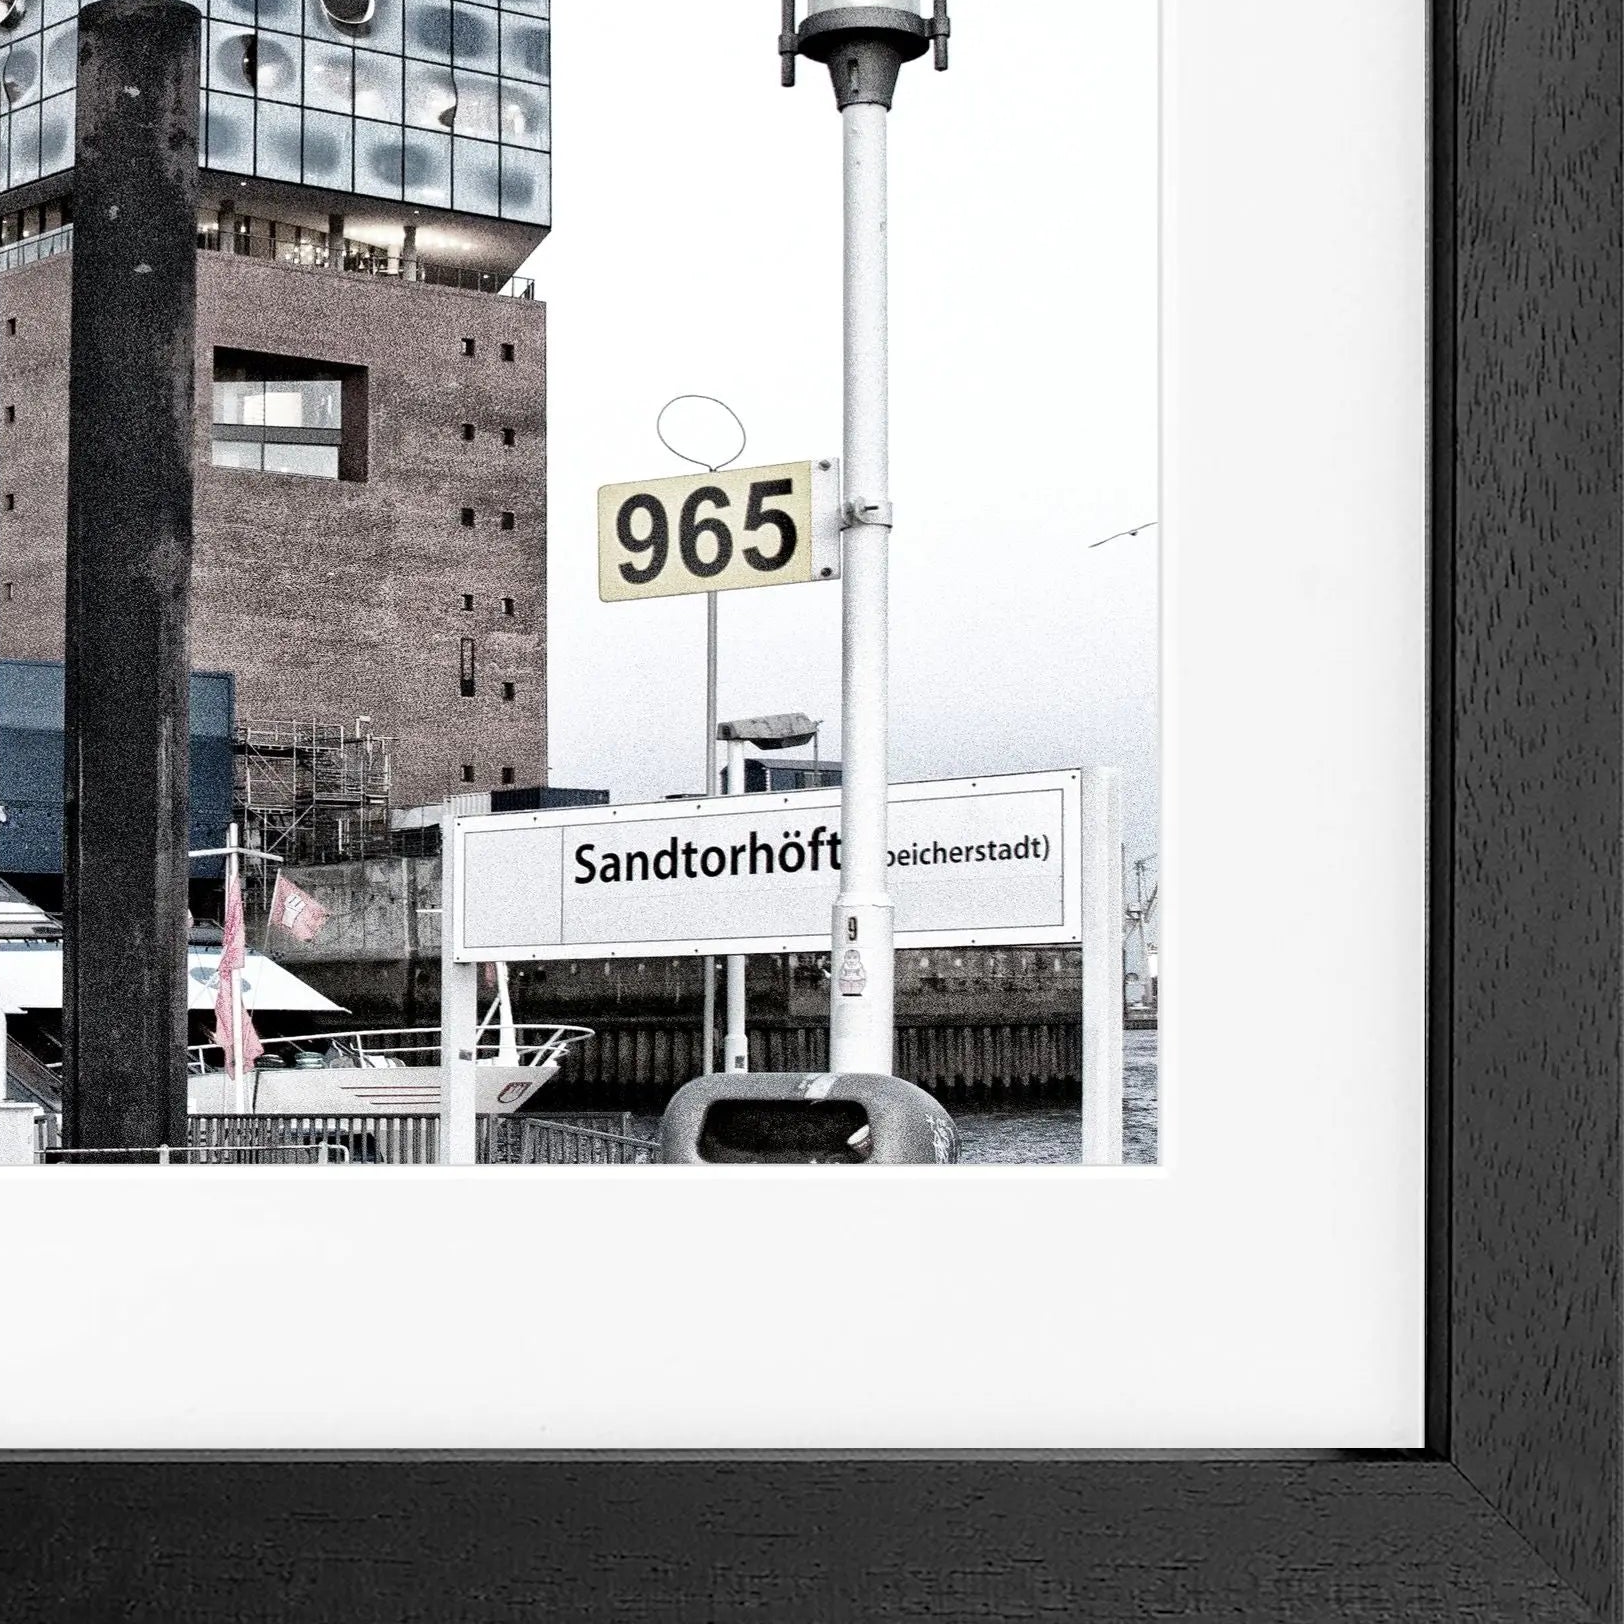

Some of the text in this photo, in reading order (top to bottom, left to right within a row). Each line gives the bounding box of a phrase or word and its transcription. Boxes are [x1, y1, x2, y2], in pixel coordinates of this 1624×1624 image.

[615, 477, 798, 585] 965
[574, 825, 1050, 885] Sandtorhöft eicherstadt)
[847, 916, 859, 942] 9
